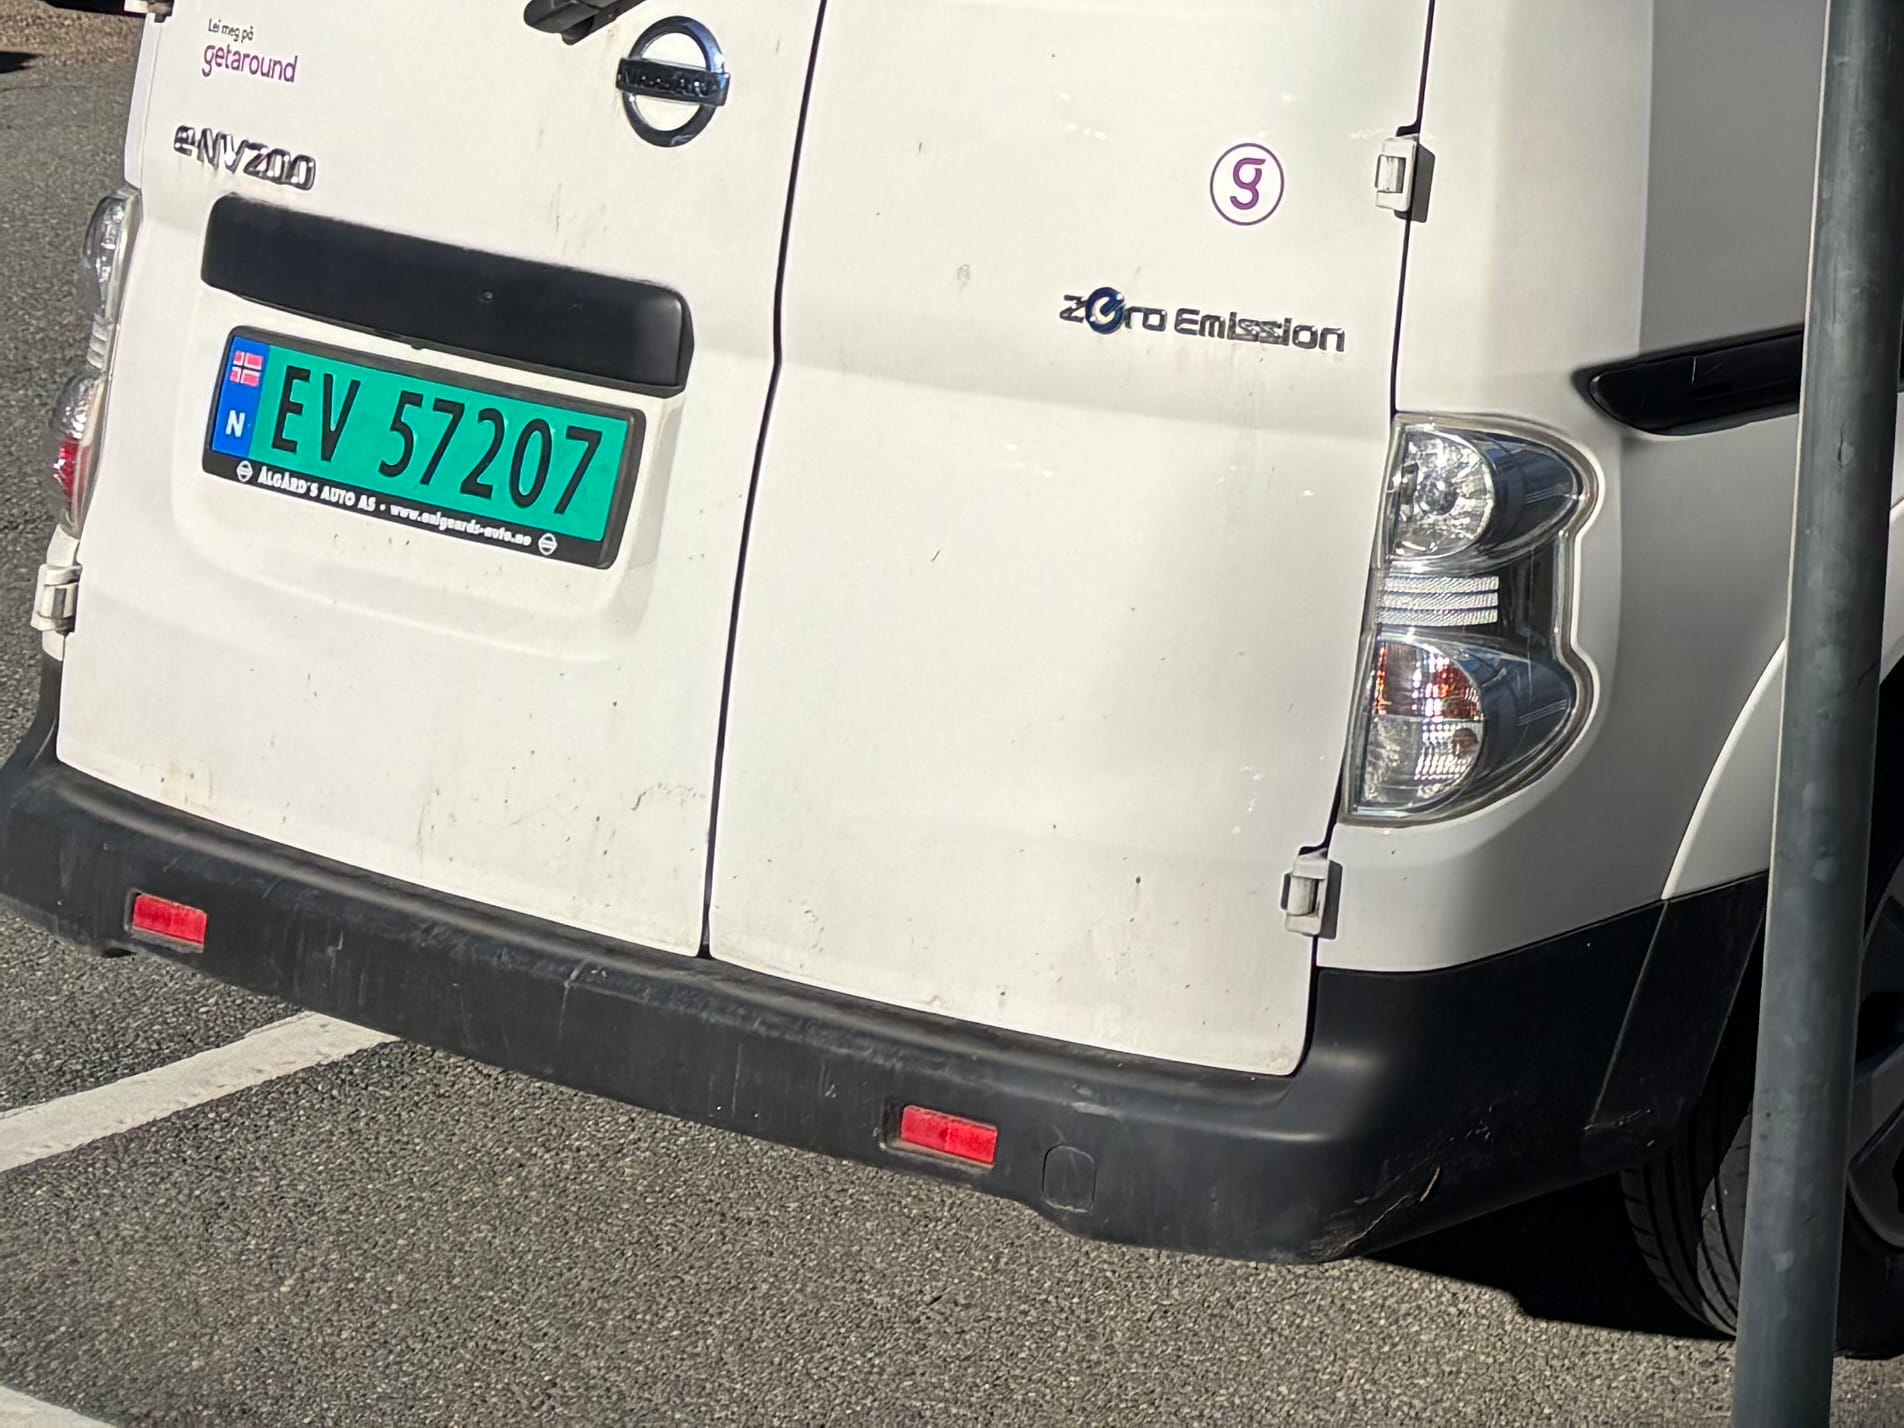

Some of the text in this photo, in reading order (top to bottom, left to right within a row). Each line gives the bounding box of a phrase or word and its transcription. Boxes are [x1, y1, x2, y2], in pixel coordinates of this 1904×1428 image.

[208, 18, 254, 43] Lei meg på
[202, 43, 298, 83] getaround
[225, 408, 246, 439] N
[272, 365, 602, 520] EV 57207
[320, 484, 356, 507] AUTO
[357, 494, 377, 512] AS
